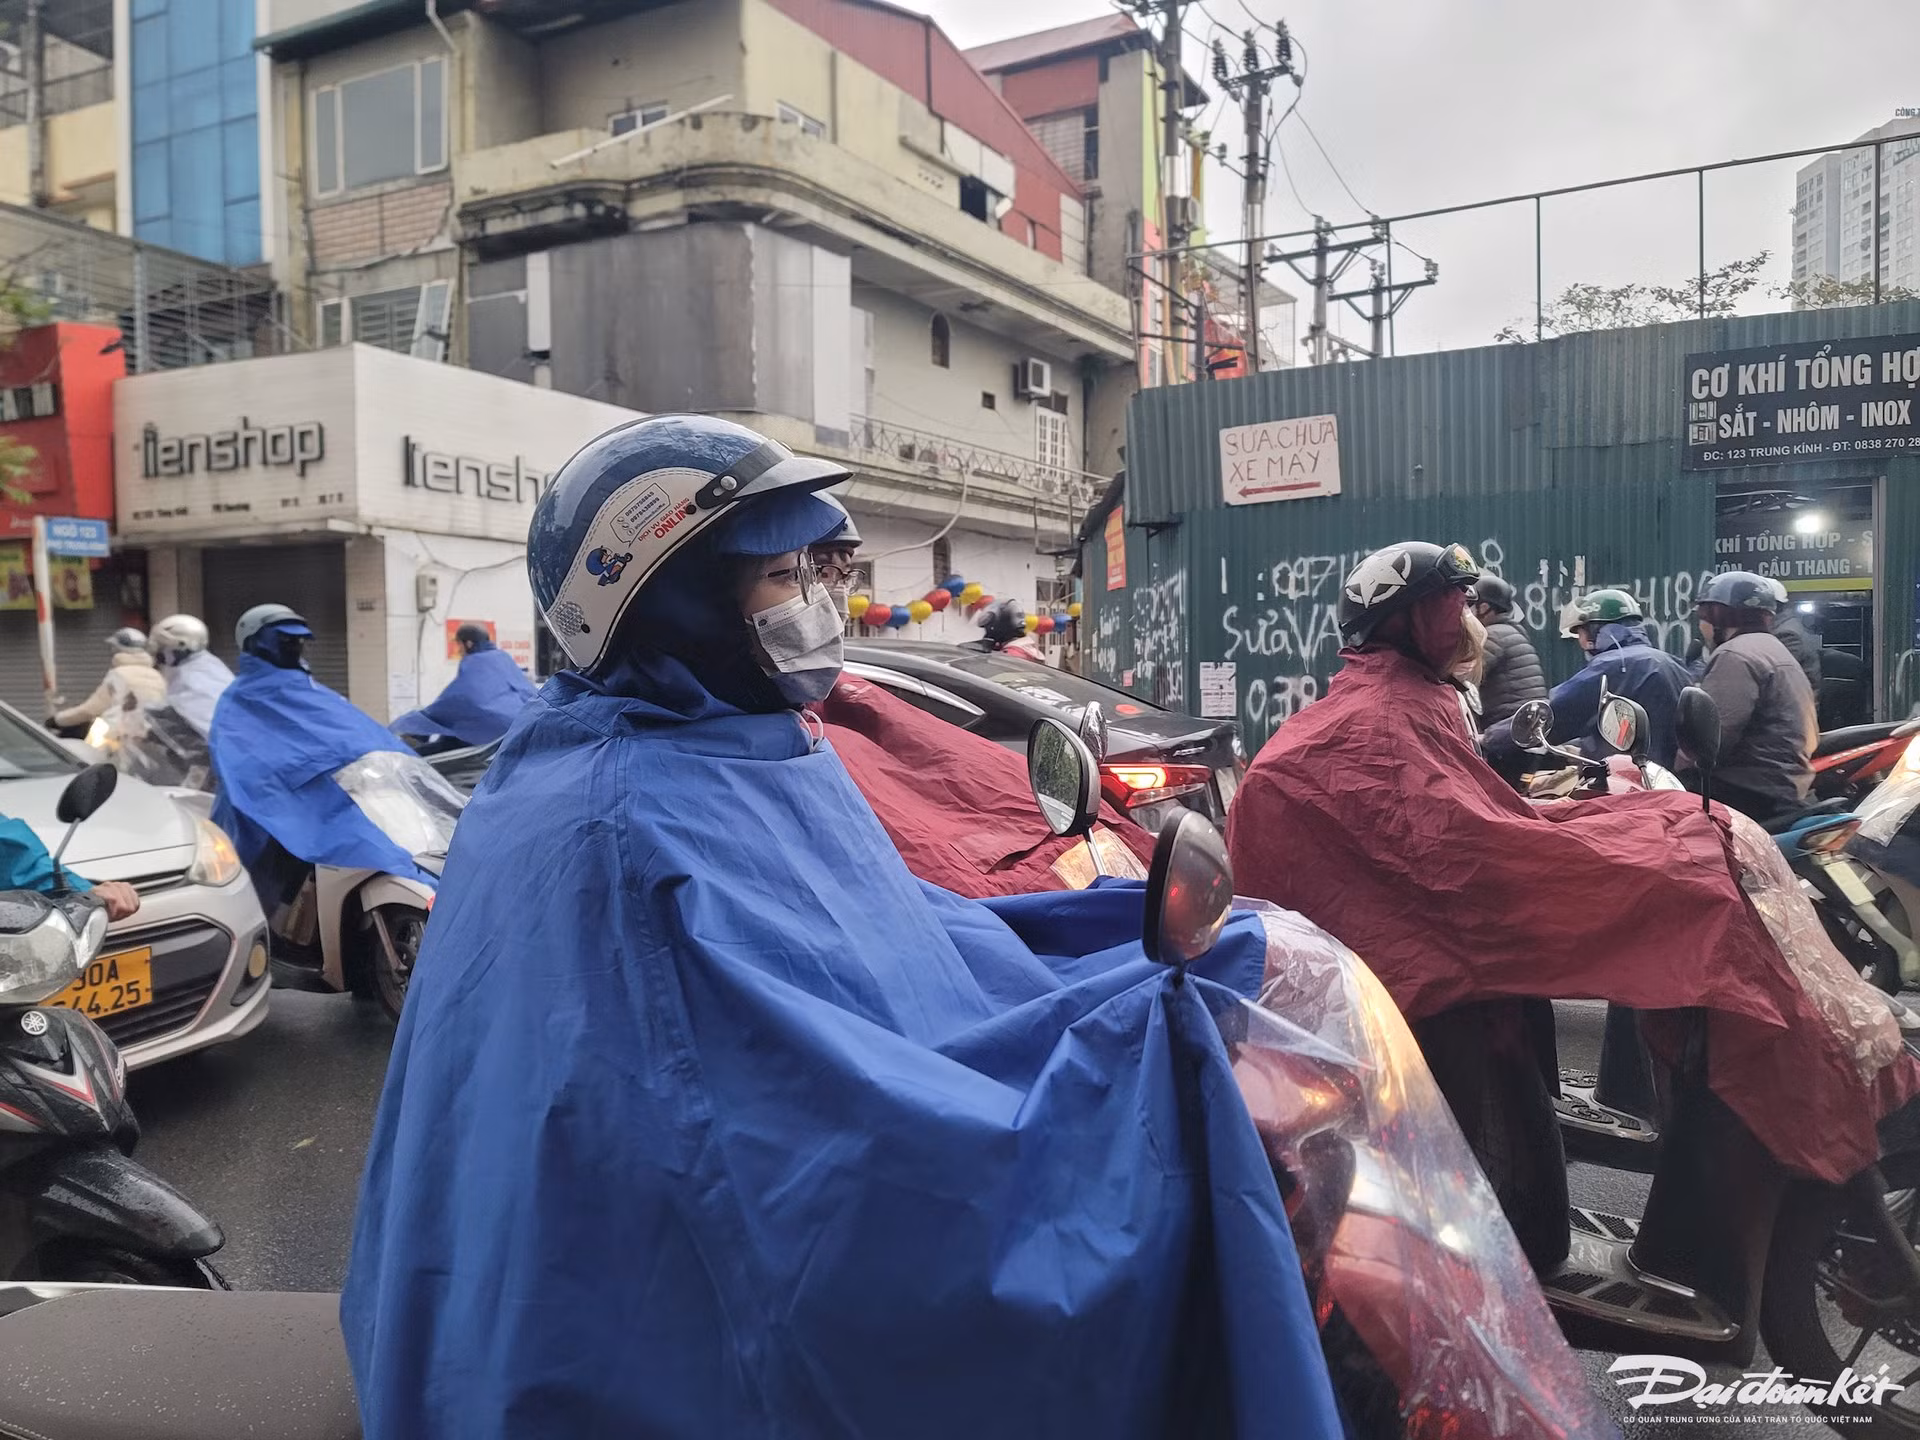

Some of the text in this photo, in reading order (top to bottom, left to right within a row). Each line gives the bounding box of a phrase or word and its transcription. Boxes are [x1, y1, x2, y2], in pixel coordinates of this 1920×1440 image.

[1691, 363, 1730, 400] CƠ
[1738, 354, 1787, 396] KHÍ
[1795, 344, 1872, 391] TỔNG
[1719, 399, 1912, 439] SẮT NHÔM INOX
[1229, 459, 1257, 483] XE
[1267, 448, 1320, 478] MÁY
[1703, 451, 1724, 462] ĐC:
[1727, 449, 1746, 460] 123
[1750, 445, 1790, 458] TRUNG
[1793, 442, 1822, 455] KÍNH
[1832, 441, 1851, 452] ĐT:
[1854, 439, 1882, 450] 0838
[1885, 437, 1905, 449] 270
[654, 507, 692, 539] ONLIN
[1746, 529, 1796, 552] TỔNG
[1758, 556, 1791, 577] CẦU
[1796, 559, 1850, 576] THANG
[52, 980, 140, 1014] 44.25
